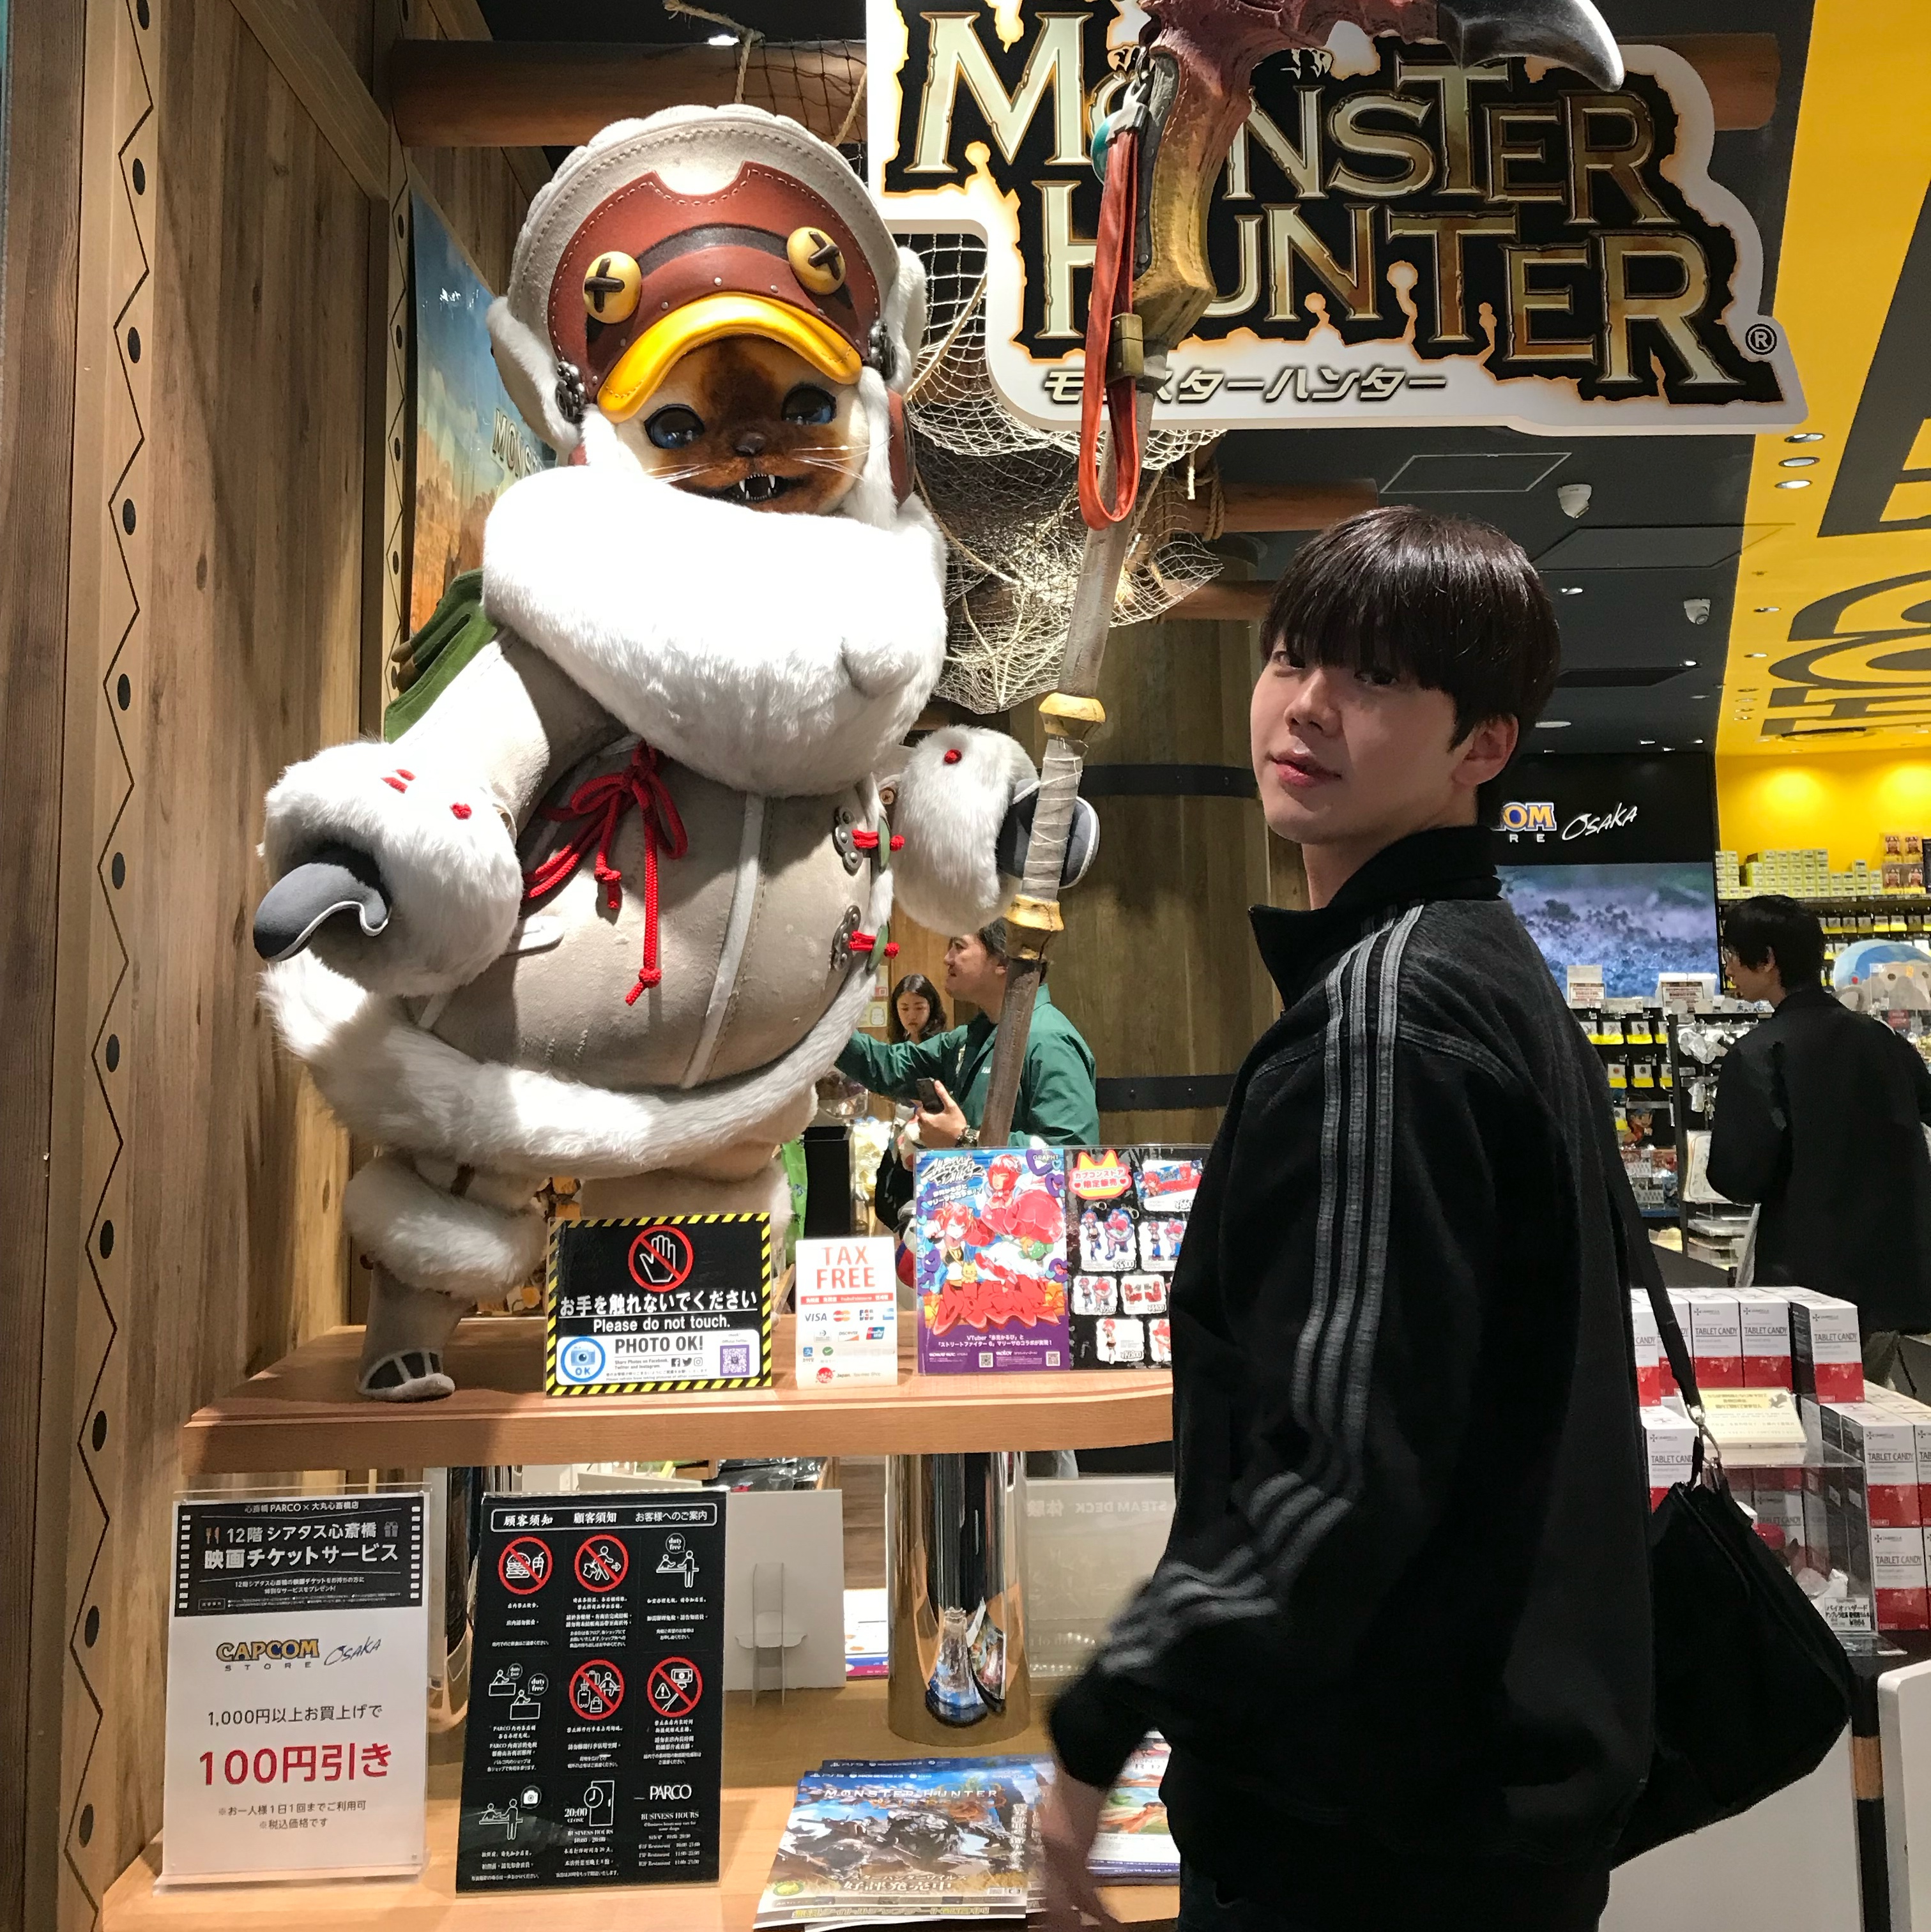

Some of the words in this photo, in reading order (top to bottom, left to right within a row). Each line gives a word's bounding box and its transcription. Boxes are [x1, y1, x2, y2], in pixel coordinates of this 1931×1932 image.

[1043, 366, 1446, 404] モターハンター
[1501, 802, 1557, 832] OM
[1509, 833, 1545, 843] RE
[1075, 1168, 1124, 1179] カプコンストア
[821, 1245, 869, 1266] TAX
[816, 1267, 876, 1290] FREE
[560, 1290, 758, 1317] お手を触れないでください
[805, 1312, 828, 1322] VISA
[593, 1319, 638, 1333] Please
[643, 1318, 660, 1330] do
[664, 1316, 685, 1330] not
[691, 1314, 731, 1329] touch.
[1695, 1327, 1717, 1335] TABLET
[1718, 1327, 1738, 1335] CANDY
[1767, 1326, 1787, 1334] CANDY
[1636, 1336, 1656, 1344] CANDY
[1836, 1332, 1858, 1341] CANDY
[614, 1337, 671, 1354] PHOTO
[675, 1335, 703, 1351] OK!
[575, 1367, 591, 1376] OK
[1651, 1455, 1675, 1463] TABLET
[1675, 1454, 1693, 1463] CAN
[1868, 1452, 1891, 1461] TABLET
[270, 1503, 301, 1512] PARCO
[635, 1510, 708, 1523] お客様へのご案内
[204, 1542, 399, 1570] 映画チケットサービス
[1875, 1556, 1900, 1564] TABLET
[1902, 1555, 1922, 1564] CANDY
[216, 1638, 320, 1662] CAPCOM
[225, 1661, 312, 1672] STORE
[208, 1705, 383, 1726] 1,000円以上お買上げで
[199, 1743, 392, 1786] 100円引き
[650, 1784, 692, 1800] PARCO
[823, 1789, 915, 1798] MONSTER
[923, 1789, 998, 1798] HUNTER
[565, 1807, 588, 1817] 20:00
[675, 1811, 699, 1819] HOURS
